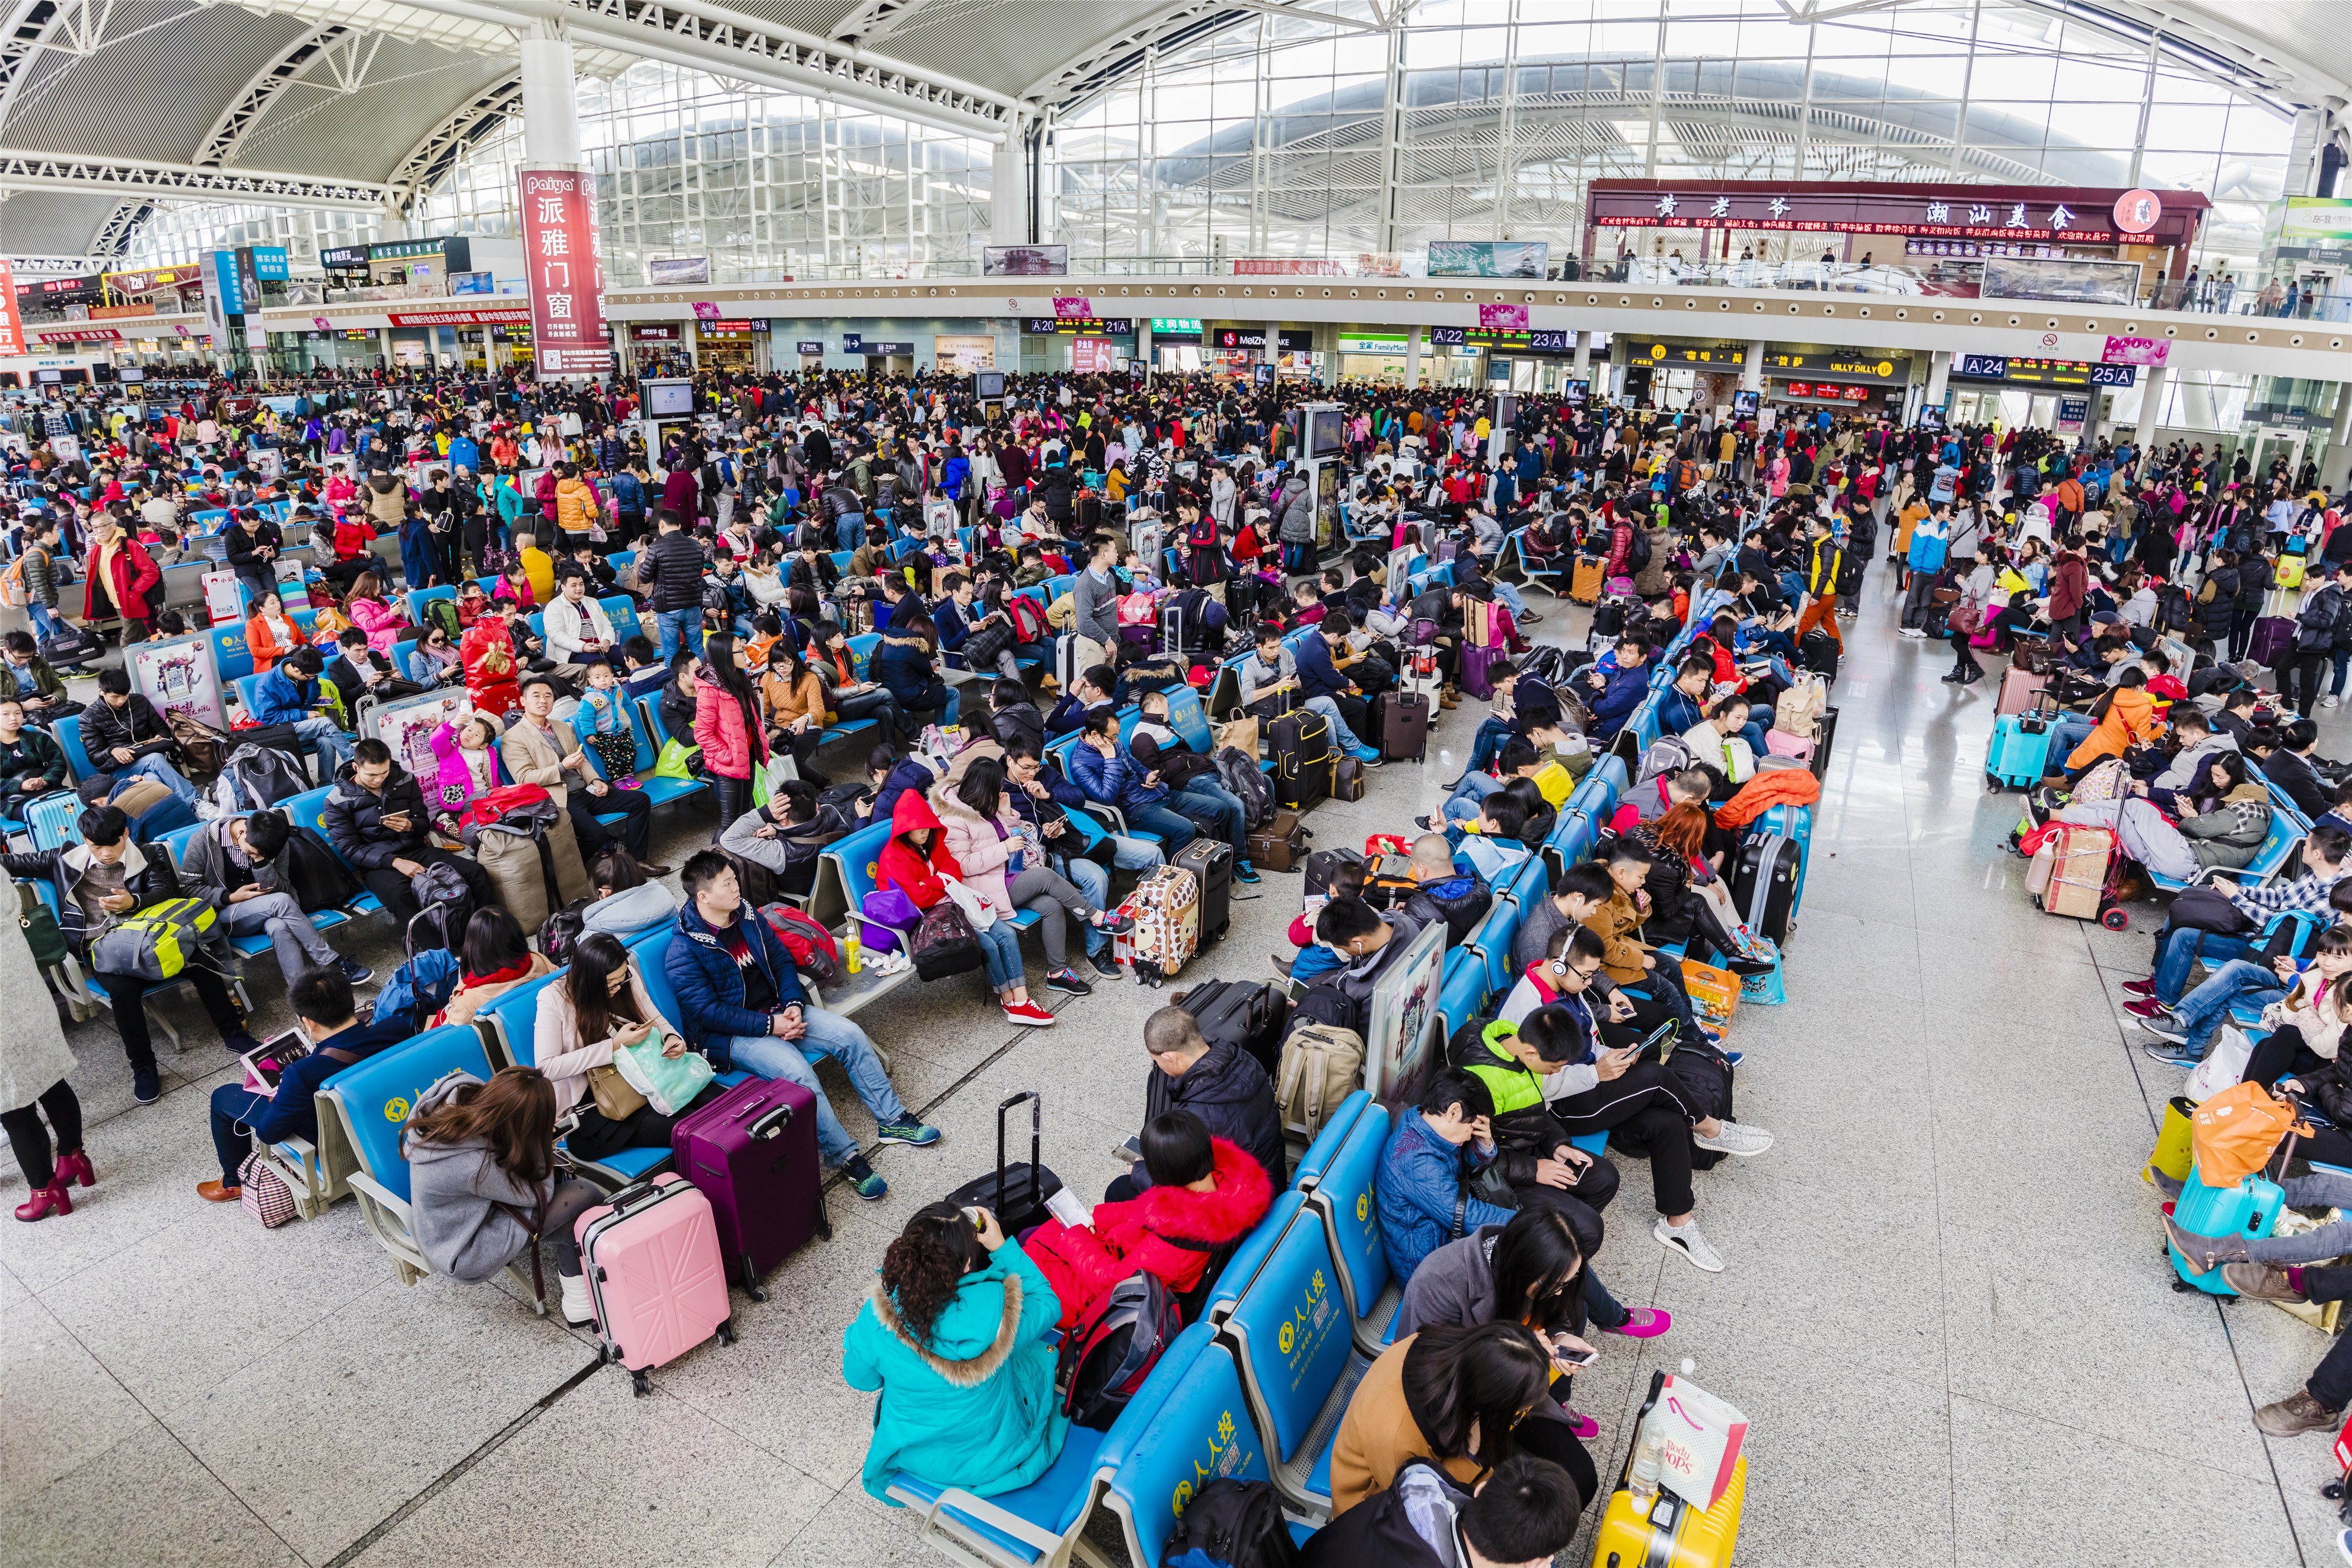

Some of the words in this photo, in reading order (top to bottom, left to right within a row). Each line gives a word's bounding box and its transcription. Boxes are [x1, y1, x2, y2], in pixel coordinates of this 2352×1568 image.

[1655, 193, 1791, 220] 黄老爷
[1927, 201, 2076, 230] 潮汕美食
[537, 196, 572, 318] 派雅门窗
[1239, 262, 1290, 273] 普及消防知识
[498, 326, 504, 334] 16
[751, 321, 760, 330] 19
[1042, 321, 1054, 331] 20
[1106, 321, 1118, 332] 21
[1153, 319, 1203, 329] 天润物流
[1447, 330, 1462, 342] 22
[1532, 333, 1549, 346] 23
[1359, 342, 1373, 350] 全家
[1854, 364, 1878, 374] DILLY
[1968, 359, 1981, 372] A
[1983, 359, 2003, 374] 24
[2092, 368, 2114, 382] 25
[2117, 370, 2131, 383] A
[610, 607, 628, 617] 人人投
[1181, 703, 1198, 718] 人人投
[1295, 1269, 1325, 1333] 人人投
[1289, 1350, 1302, 1371] 开分店
[1196, 1410, 1236, 1490] 人人投
[1666, 1439, 1690, 1461] Body
